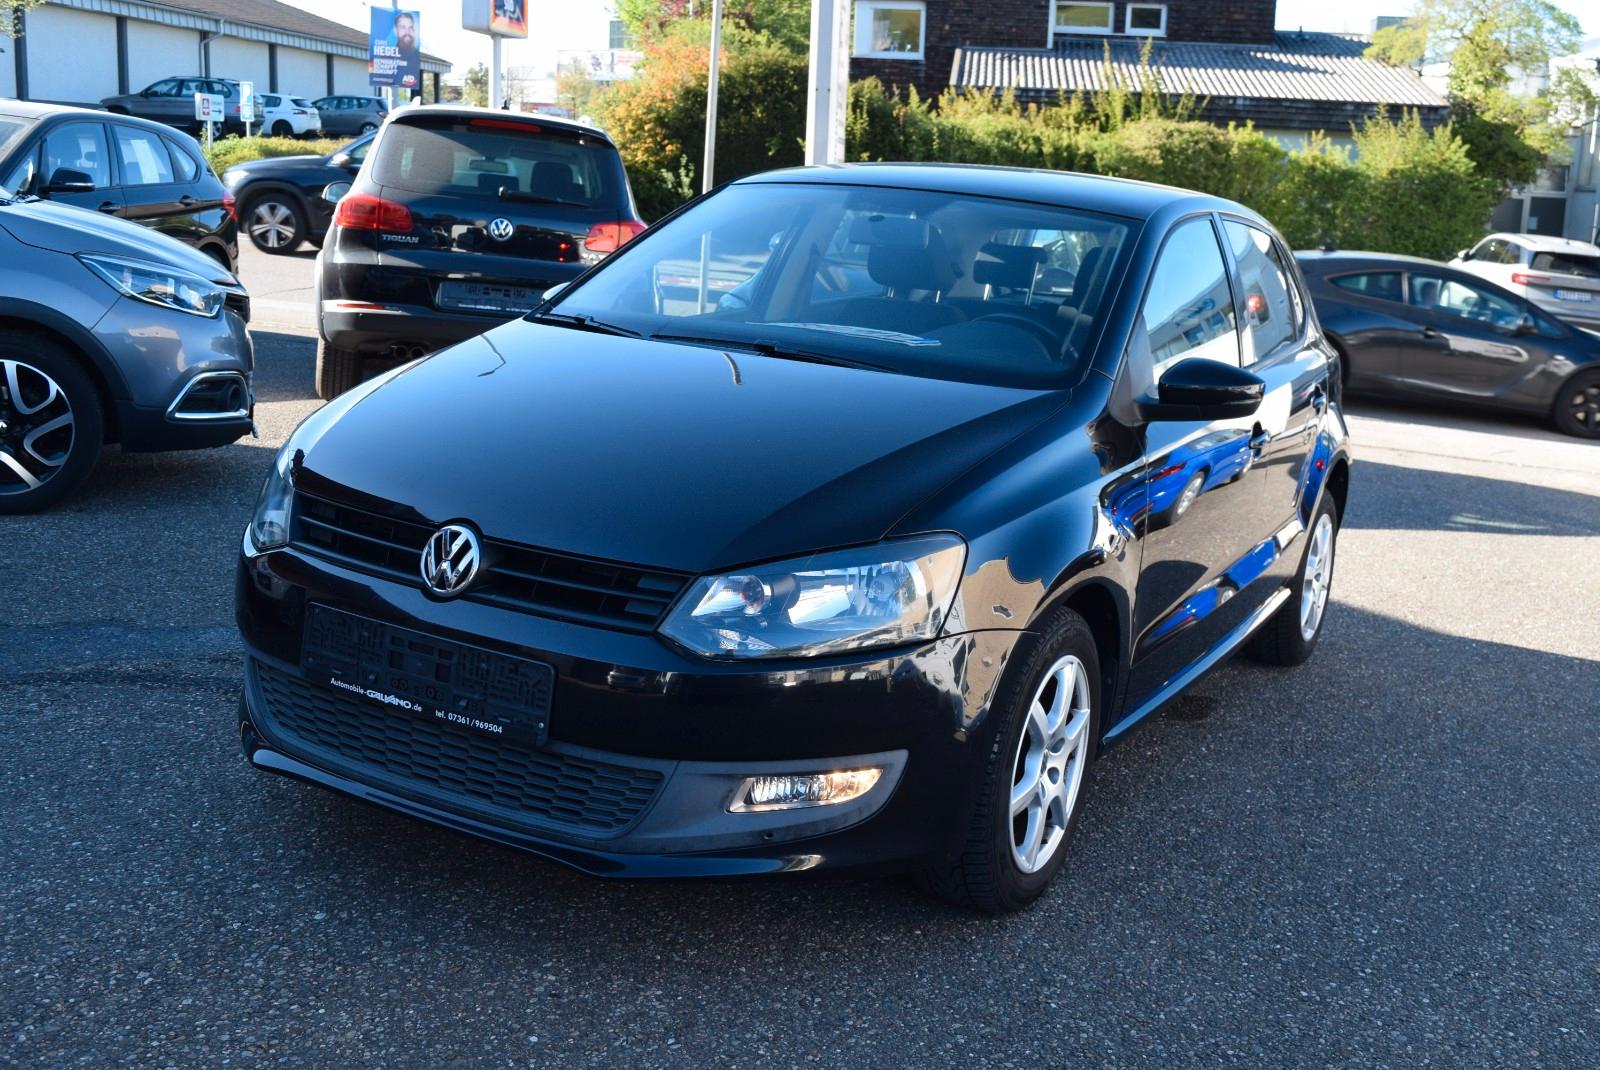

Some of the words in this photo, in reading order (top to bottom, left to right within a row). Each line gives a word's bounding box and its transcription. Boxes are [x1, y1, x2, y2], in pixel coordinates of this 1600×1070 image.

[374, 46, 401, 57] HEGEL
[381, 233, 420, 244] TIGUAN
[435, 709, 446, 719] tel.
[448, 713, 503, 734] 07361/969504
